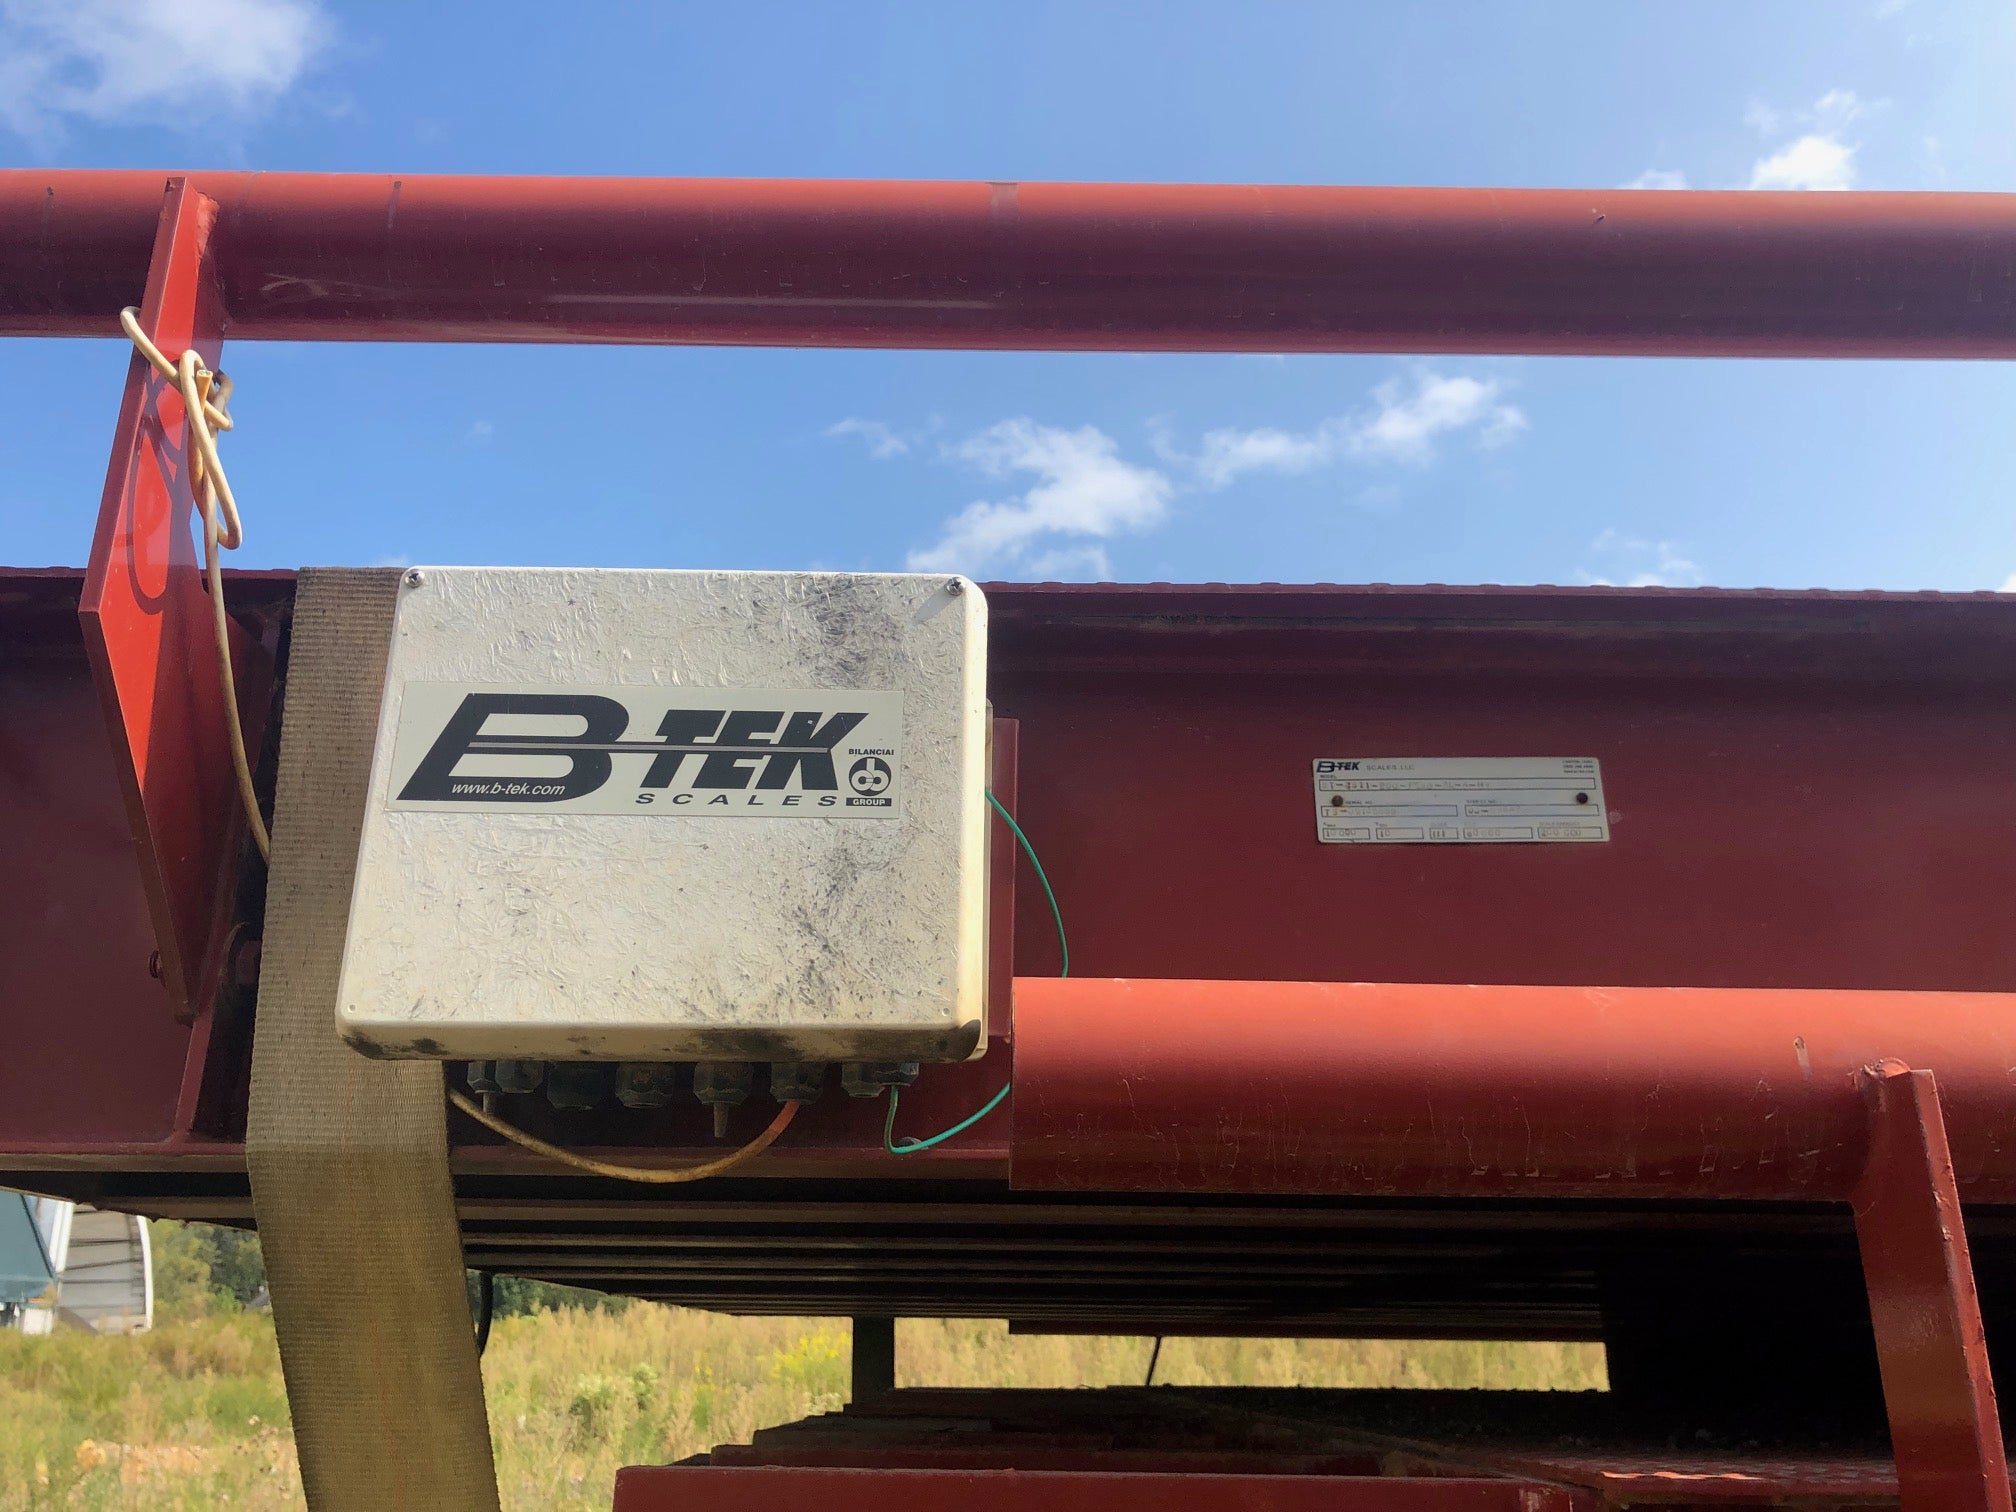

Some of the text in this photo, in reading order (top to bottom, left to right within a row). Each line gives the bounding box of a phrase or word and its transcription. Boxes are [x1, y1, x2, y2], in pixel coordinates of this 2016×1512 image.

[395, 693, 869, 803] B-TEK
[848, 748, 895, 756] BILANCIAI
[1316, 761, 1360, 773] B-TEK
[451, 781, 566, 797] www.b-tek.com
[635, 792, 838, 808] SCALES
[852, 798, 886, 806] GROUP
